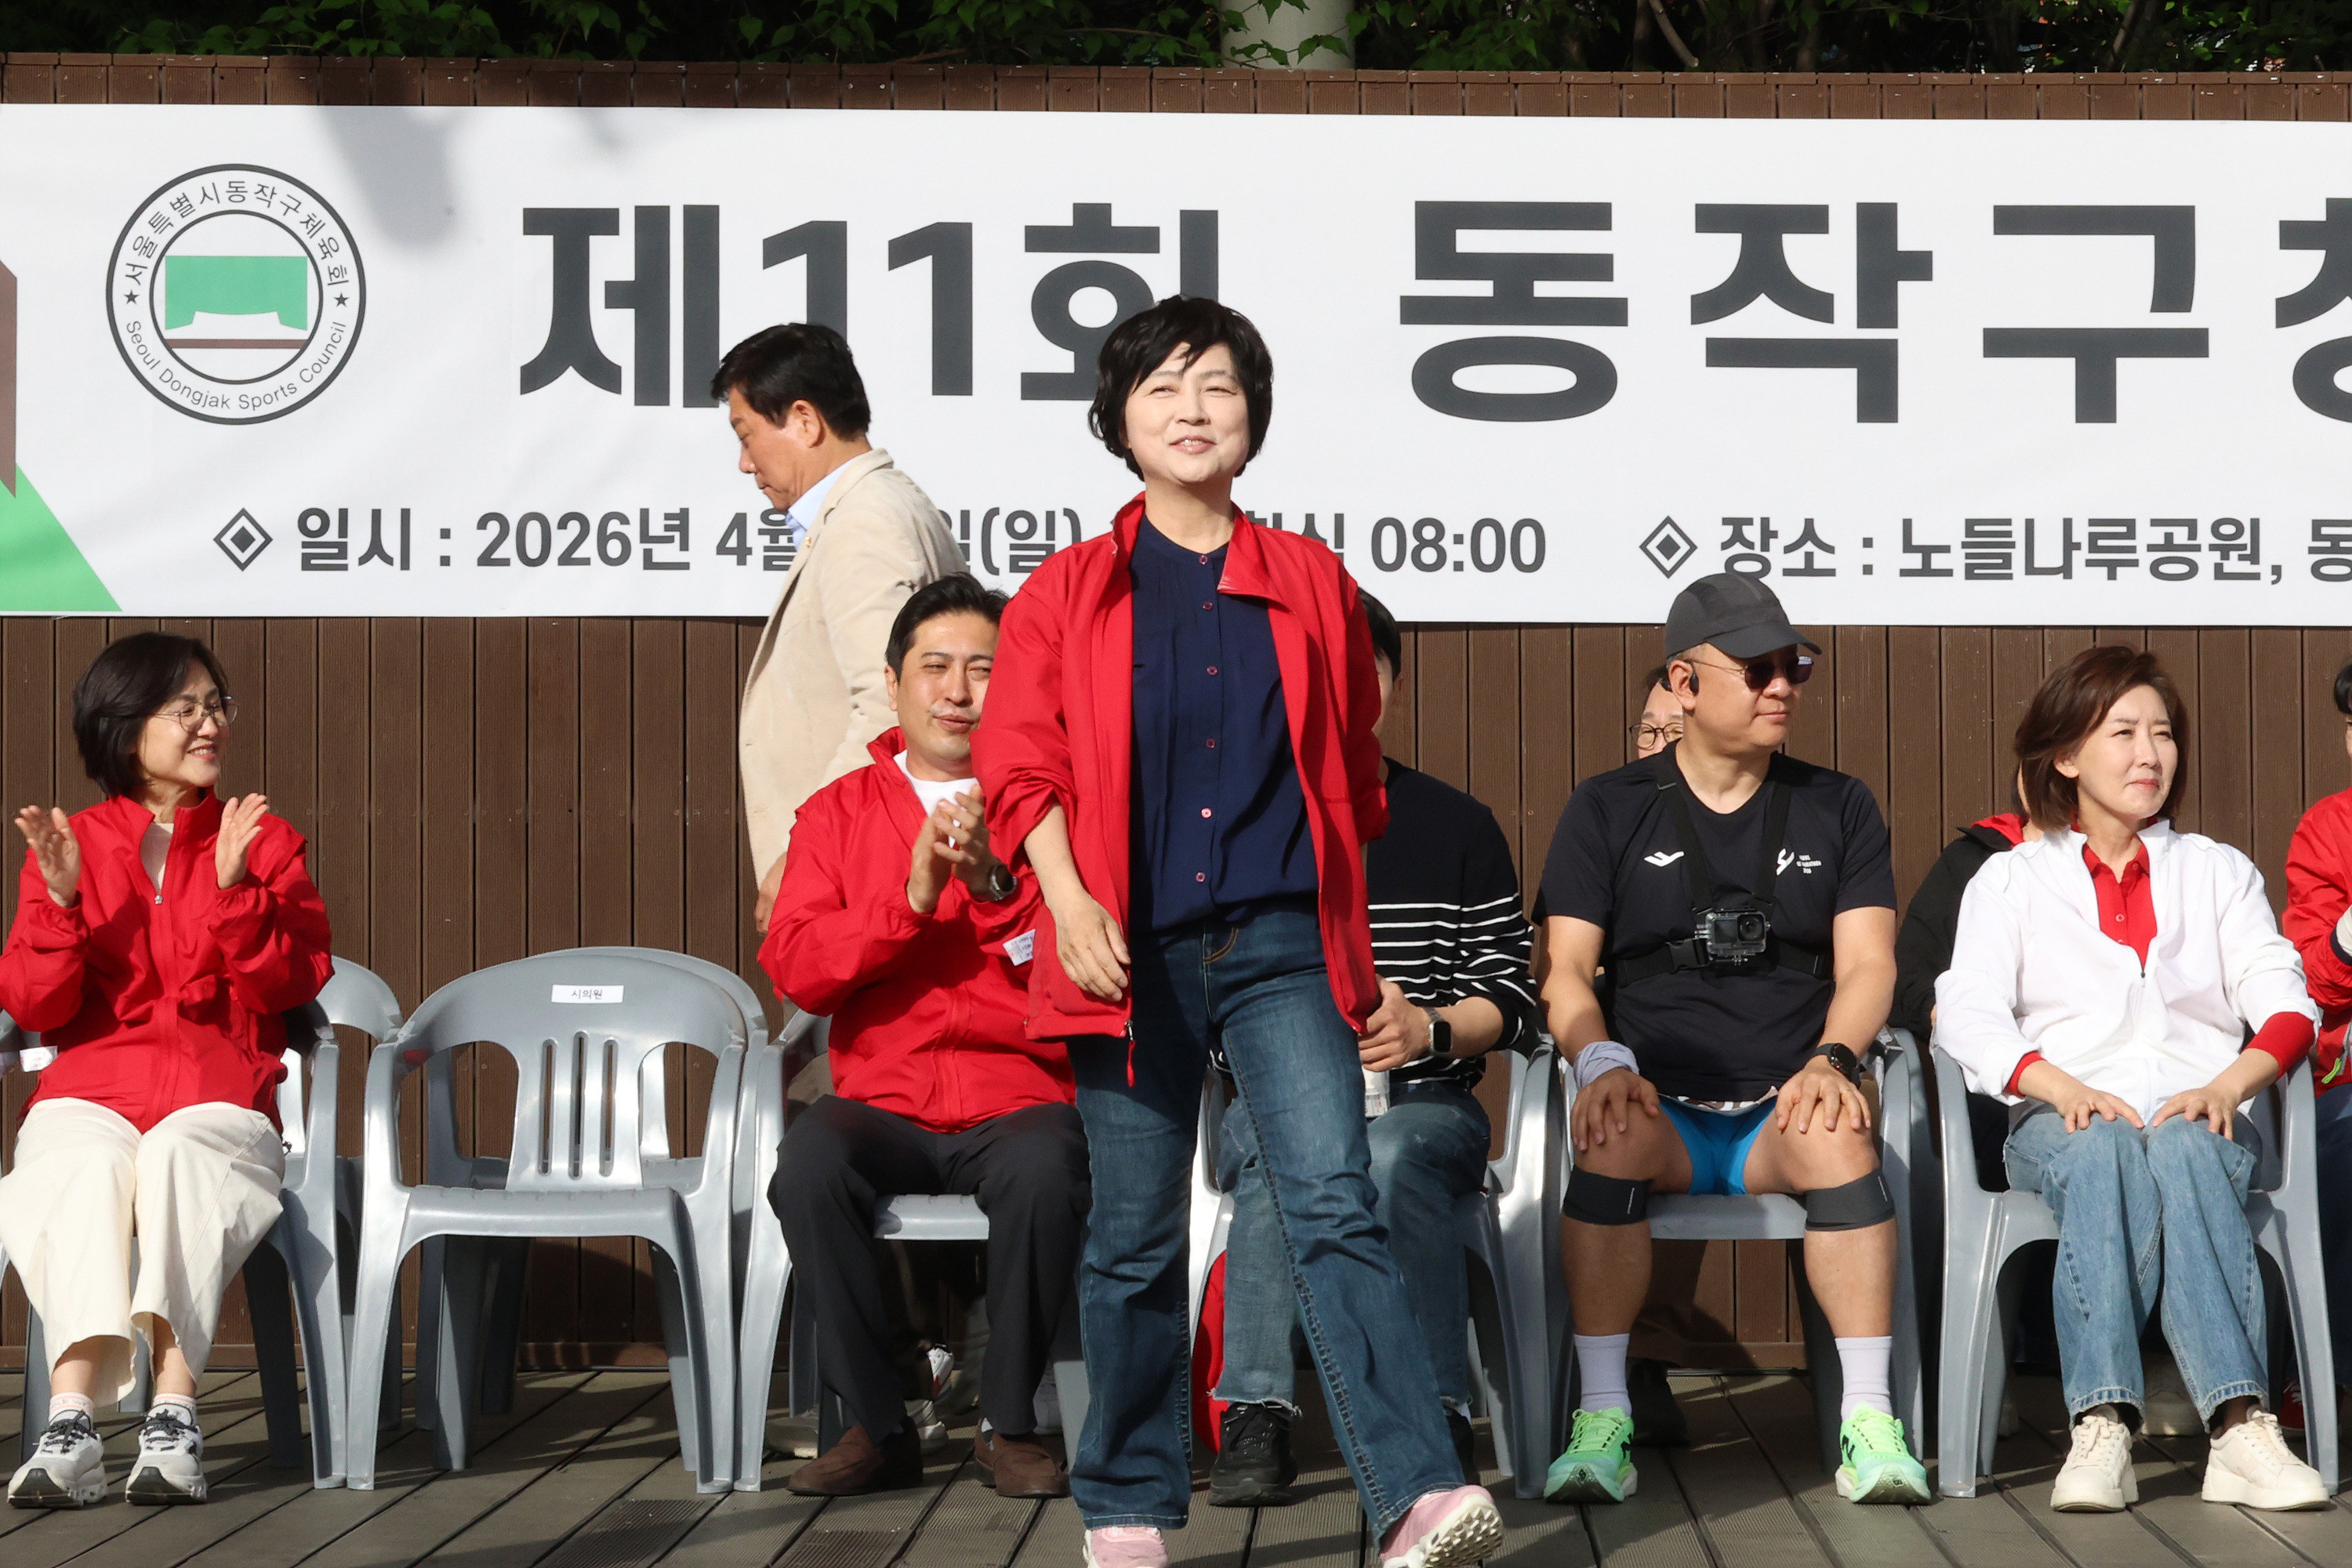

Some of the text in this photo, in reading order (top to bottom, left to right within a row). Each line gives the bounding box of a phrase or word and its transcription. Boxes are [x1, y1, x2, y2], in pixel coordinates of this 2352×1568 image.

[125, 180, 350, 286] 서울특별시동작구체육회
[126, 320, 347, 411] Seoul Dongjak Sports Council
[297, 507, 411, 572] 일시
[440, 528, 451, 567] :
[476, 507, 691, 572] 2026년
[1370, 517, 1546, 573] 08:00
[1720, 517, 1836, 579] 장소
[1862, 537, 1873, 575] :
[1899, 517, 2282, 585] 노들나루공원,
[571, 989, 603, 1000] 시의원
